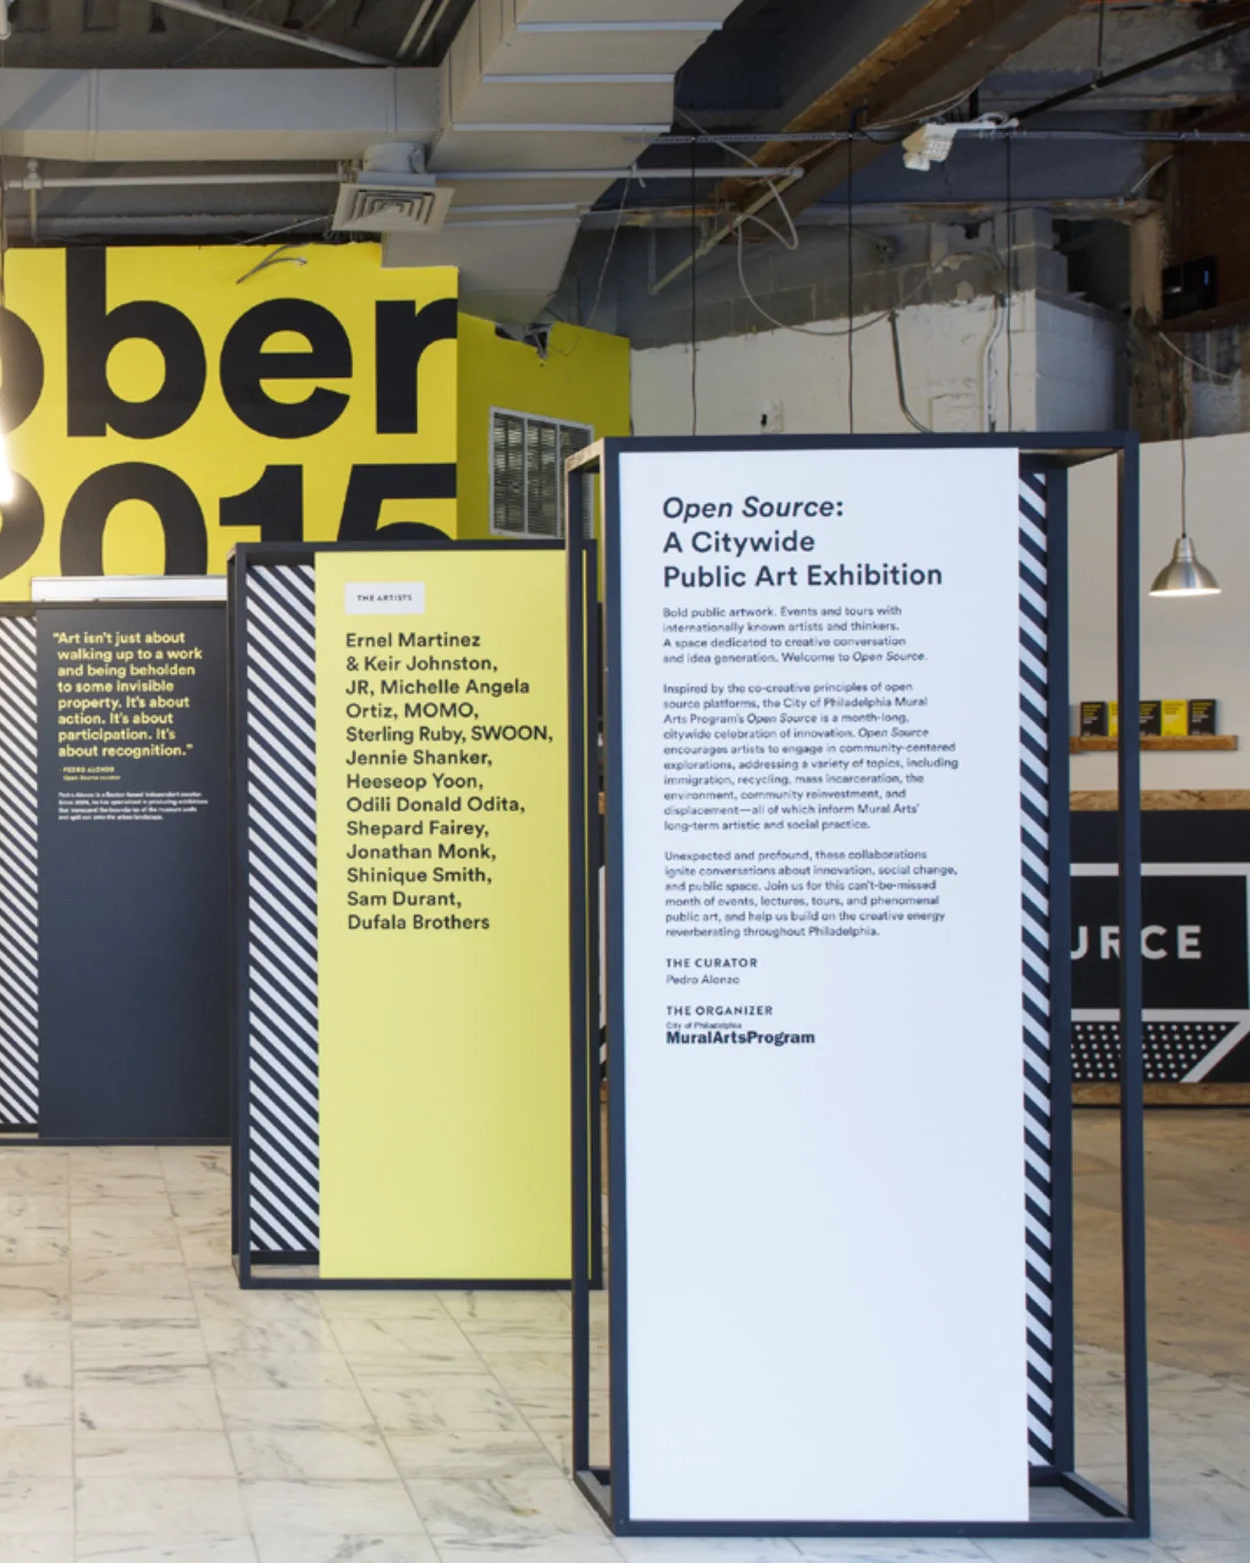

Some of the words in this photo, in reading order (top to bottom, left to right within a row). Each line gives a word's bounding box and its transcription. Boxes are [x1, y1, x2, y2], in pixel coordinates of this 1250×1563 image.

[663, 497, 733, 523] Open
[742, 496, 843, 517] Source:
[663, 532, 682, 553] A
[692, 530, 815, 557] Citywide
[664, 565, 746, 587] Public
[755, 565, 797, 586] Art
[808, 563, 942, 585] Exhibition
[663, 608, 688, 618] Bold
[691, 607, 726, 618] public
[780, 606, 818, 616] Events
[821, 607, 842, 616] and
[845, 607, 874, 616] tours
[877, 606, 902, 615] with
[663, 622, 744, 634] internationally
[747, 622, 785, 631] known
[788, 622, 823, 631] artists
[827, 622, 847, 631] and
[114, 632, 141, 646] just
[145, 632, 185, 643] about
[346, 632, 392, 647] Ernel
[399, 632, 480, 647] Martinez
[663, 639, 671, 647] A
[675, 640, 707, 649] space
[710, 637, 767, 647] dedicated
[770, 639, 782, 647] to
[785, 638, 830, 647] creative
[833, 636, 906, 647] conversation
[57, 648, 112, 663] walking
[116, 651, 134, 662] up
[137, 649, 152, 659] to
[155, 650, 163, 659] a
[167, 647, 202, 659] work
[664, 654, 684, 663] and
[687, 654, 711, 663] idea
[782, 652, 835, 662] Welcome
[838, 653, 850, 662] to
[852, 651, 883, 663] Open
[58, 664, 83, 677] and
[87, 663, 126, 679] being
[130, 664, 195, 676] beholden
[347, 656, 358, 671] &
[365, 656, 401, 671] Keir
[406, 655, 498, 672] Johnston,
[57, 682, 72, 693] to
[76, 683, 113, 692] some
[117, 680, 174, 692] invisible
[346, 680, 374, 696] JR,
[381, 679, 460, 694] Michelle
[466, 678, 530, 697] Angela
[663, 683, 708, 695] Inspired
[711, 683, 724, 695] by
[728, 683, 745, 693] the
[748, 684, 811, 693] co-creative
[813, 682, 868, 694] principles
[870, 682, 882, 692] of
[885, 684, 913, 693] open
[58, 697, 122, 711] property.
[149, 695, 189, 708] about
[346, 703, 398, 720] Ortiz,
[405, 702, 479, 720] MOMO,
[58, 712, 106, 724] action.
[133, 712, 173, 724] about
[58, 728, 152, 743] participation.
[347, 726, 414, 745] Sterling
[419, 726, 466, 744] Ruby,
[471, 725, 553, 743] SWOON,
[58, 744, 98, 757] about
[346, 750, 407, 765] Jennie
[414, 749, 492, 767] Shanker,
[347, 774, 427, 791] Heeseop
[432, 773, 483, 790] Yoon,
[347, 796, 390, 812] Odili
[397, 796, 461, 812] Donald
[467, 796, 525, 814] Odita,
[347, 820, 423, 839] Shepard
[429, 819, 489, 838] Fairey,
[347, 844, 432, 859] Jonathan
[438, 843, 496, 861] Monk,
[347, 867, 427, 886] Shinique
[433, 867, 492, 885] Smith,
[348, 891, 386, 906] Sam
[393, 891, 461, 908] Durant,
[349, 914, 406, 929] Dufala
[413, 914, 490, 929] Brothers
[666, 958, 690, 967] THE
[694, 958, 757, 968] CURATOR
[667, 975, 699, 984] Pedro
[701, 975, 740, 984] Alonzo
[667, 1006, 691, 1016] THE
[695, 1006, 772, 1016] ORGANIZER
[666, 1031, 815, 1046] MuralArtsProgram
